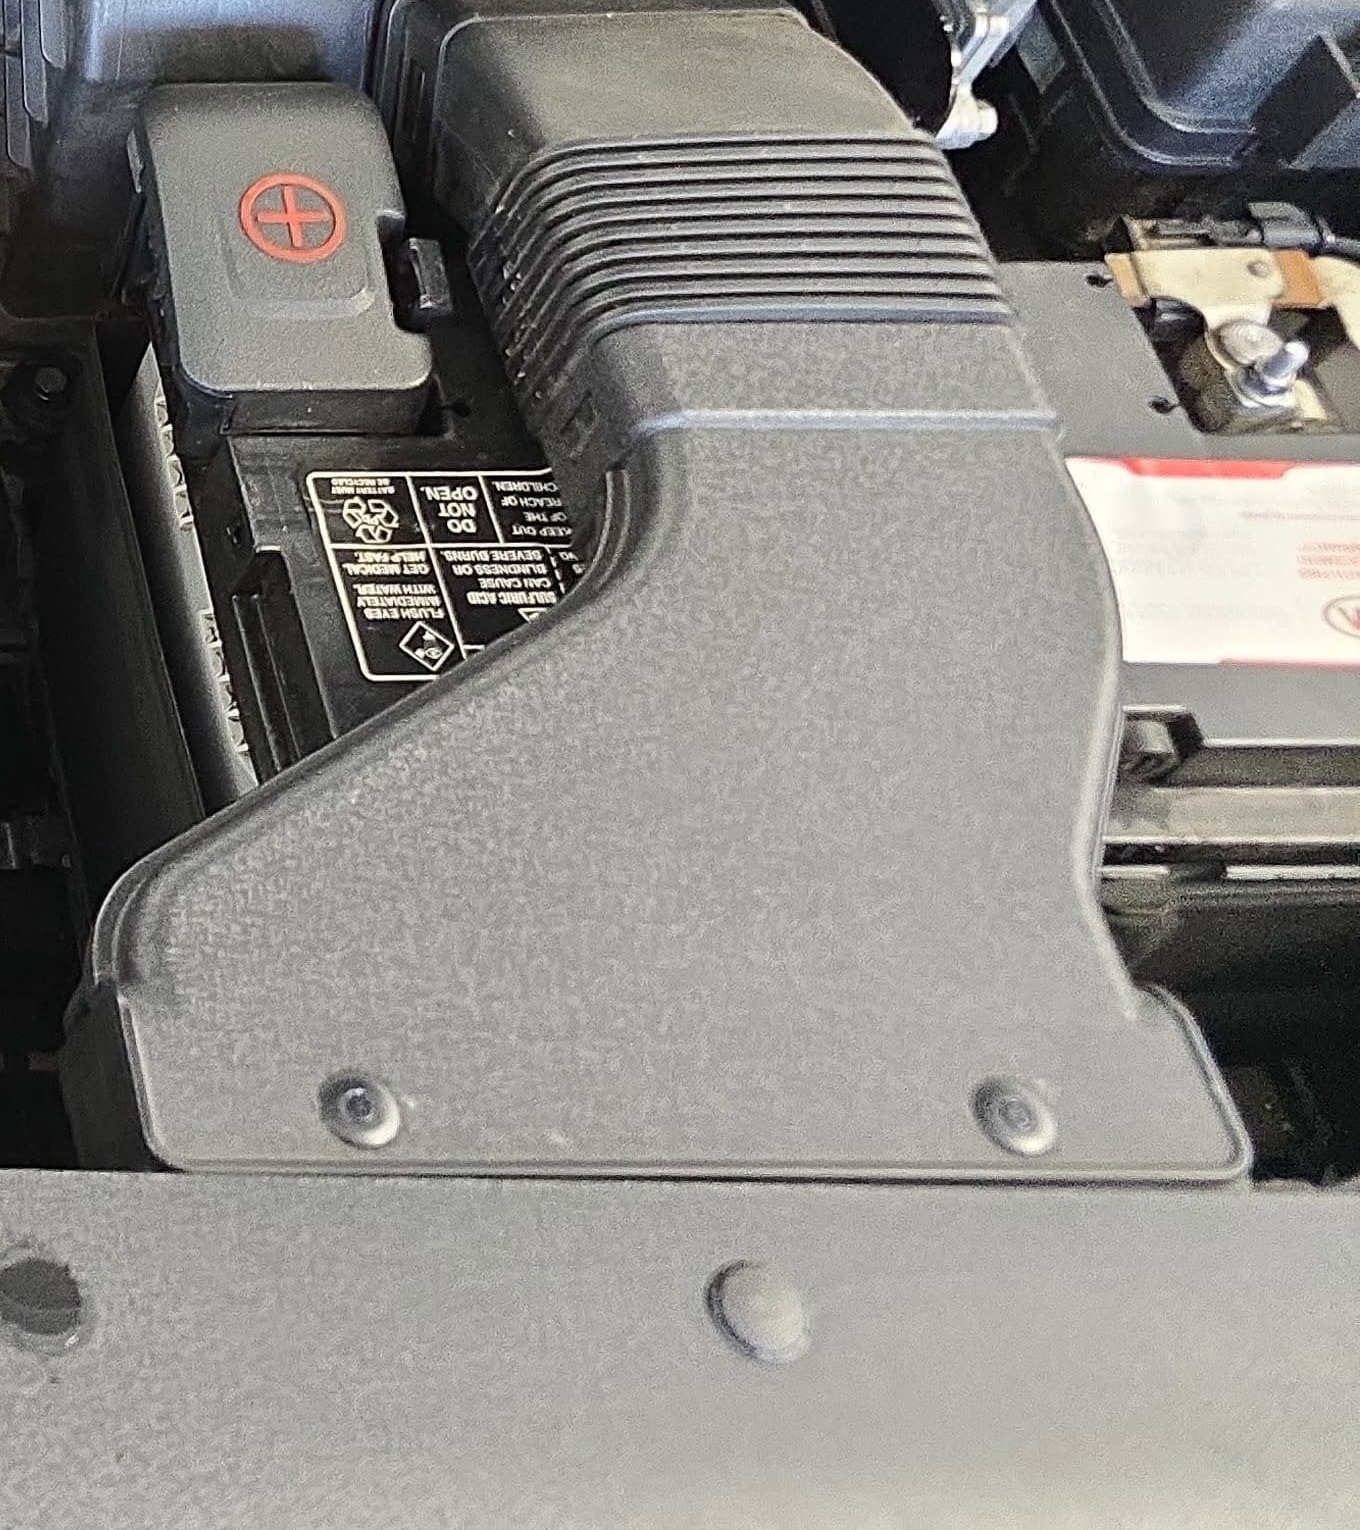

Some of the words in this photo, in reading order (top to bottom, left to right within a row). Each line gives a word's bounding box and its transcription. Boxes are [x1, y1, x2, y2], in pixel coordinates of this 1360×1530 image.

[420, 485, 479, 501] OPEN.
[501, 495, 518, 506] OF
[520, 497, 562, 507] REACH
[438, 502, 476, 517] NOT
[523, 511, 549, 522] THE
[446, 518, 477, 533] DO
[511, 525, 537, 536] OUT
[391, 550, 426, 562] HELP
[490, 550, 543, 561] SEVERE
[402, 563, 431, 575] GET
[452, 563, 473, 575] OR
[474, 563, 547, 575] BLINDNESS
[478, 577, 522, 589] CAUSE
[523, 577, 551, 588] CAN
[402, 583, 436, 595] WITH
[357, 596, 442, 608] IMMEDIATELY
[466, 591, 497, 605] ACID
[498, 591, 557, 605] SULFURIC
[363, 608, 400, 620] EYES
[401, 608, 445, 619] FLUSH
